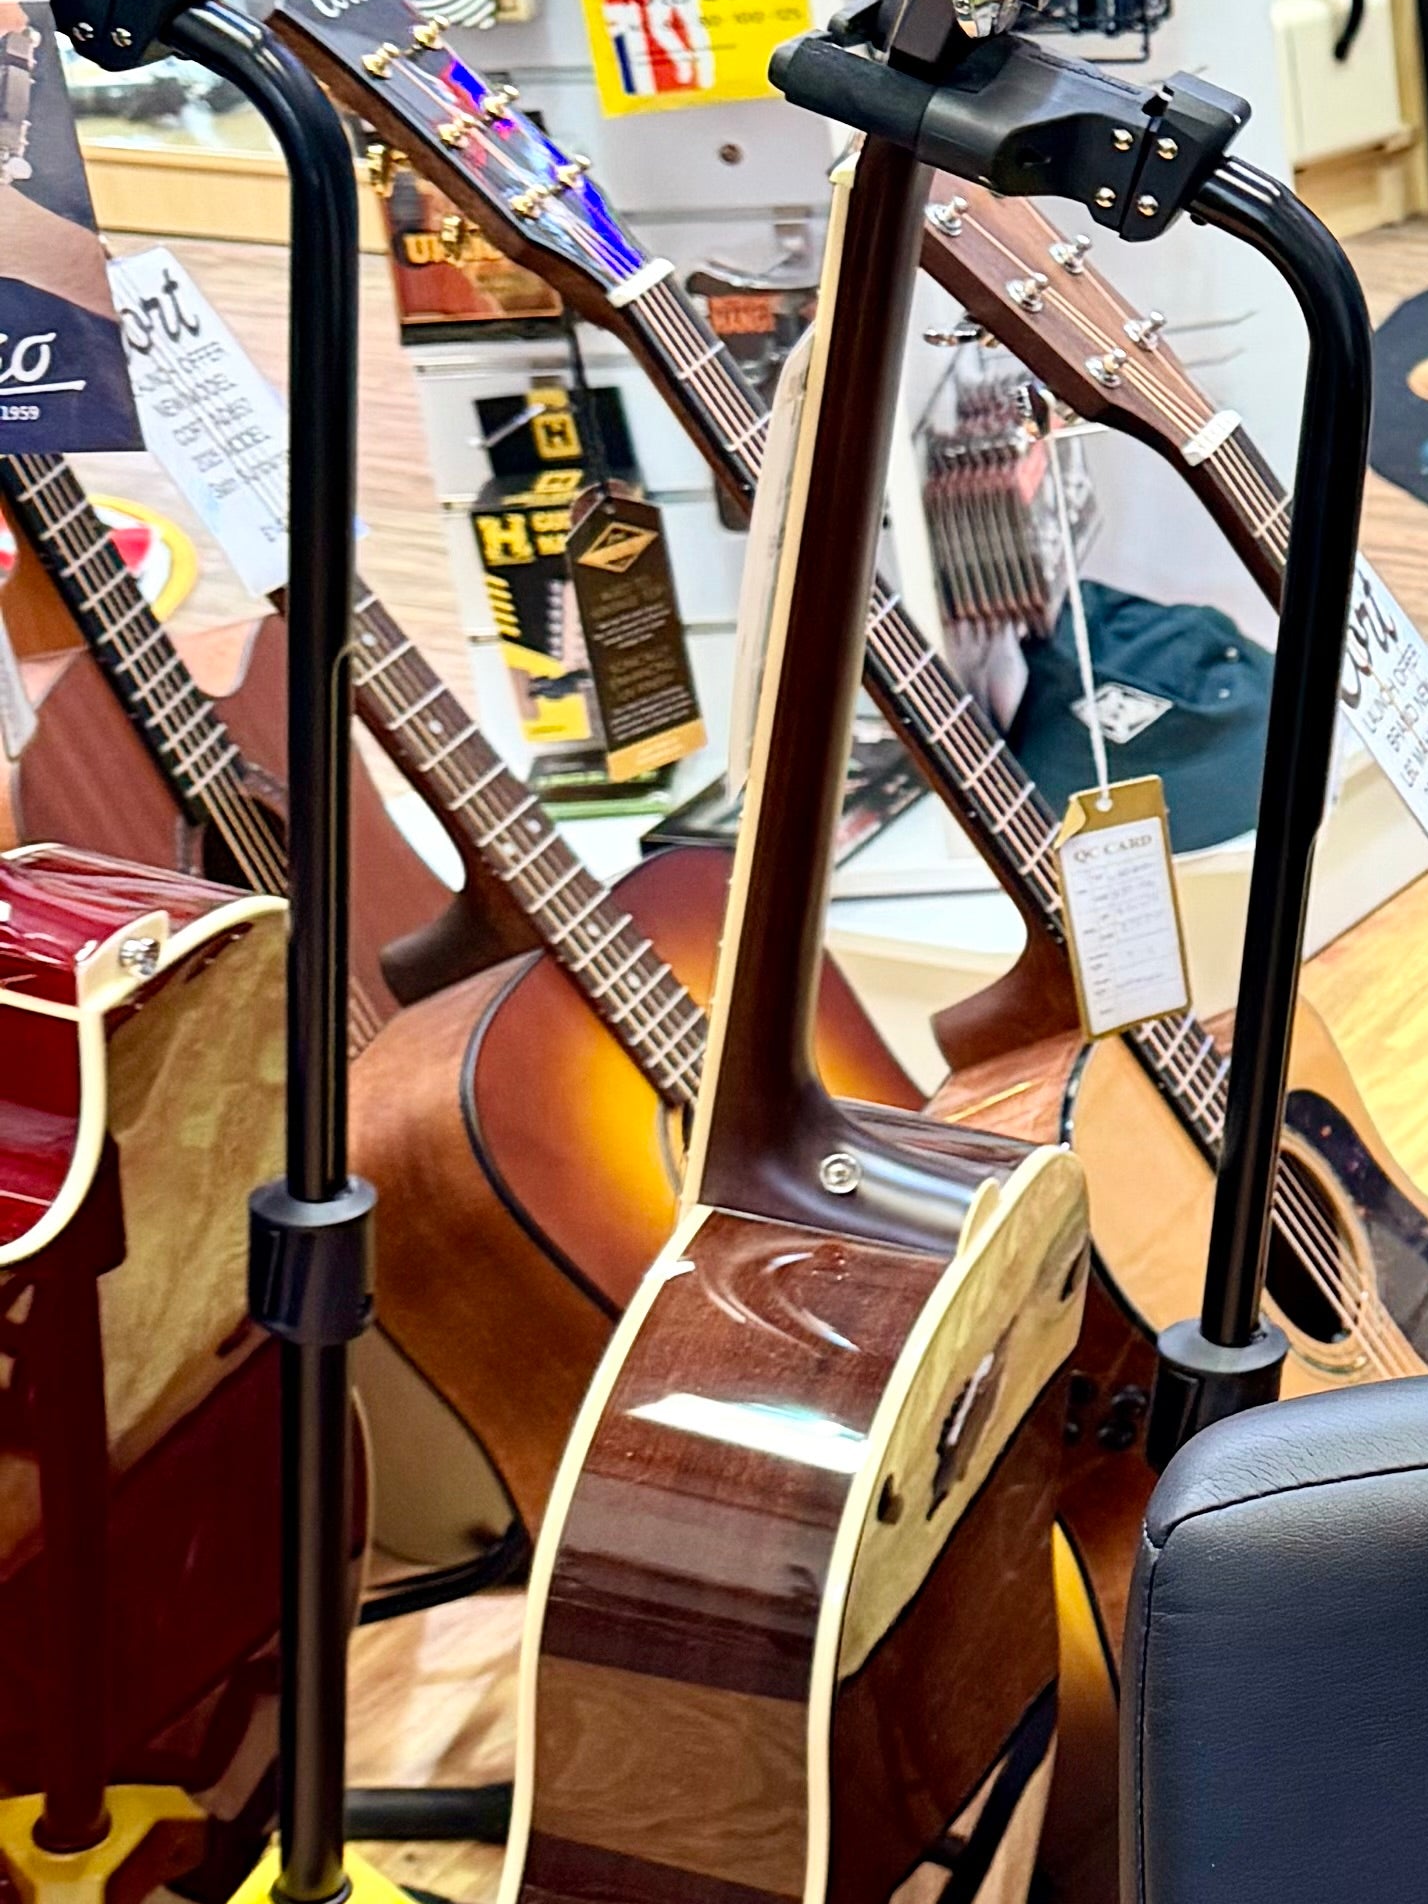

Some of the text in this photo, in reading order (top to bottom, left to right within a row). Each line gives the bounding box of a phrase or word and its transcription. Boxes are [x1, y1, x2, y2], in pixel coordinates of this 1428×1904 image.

[121, 268, 200, 356] ort
[1073, 834, 1152, 864] QC CARD
